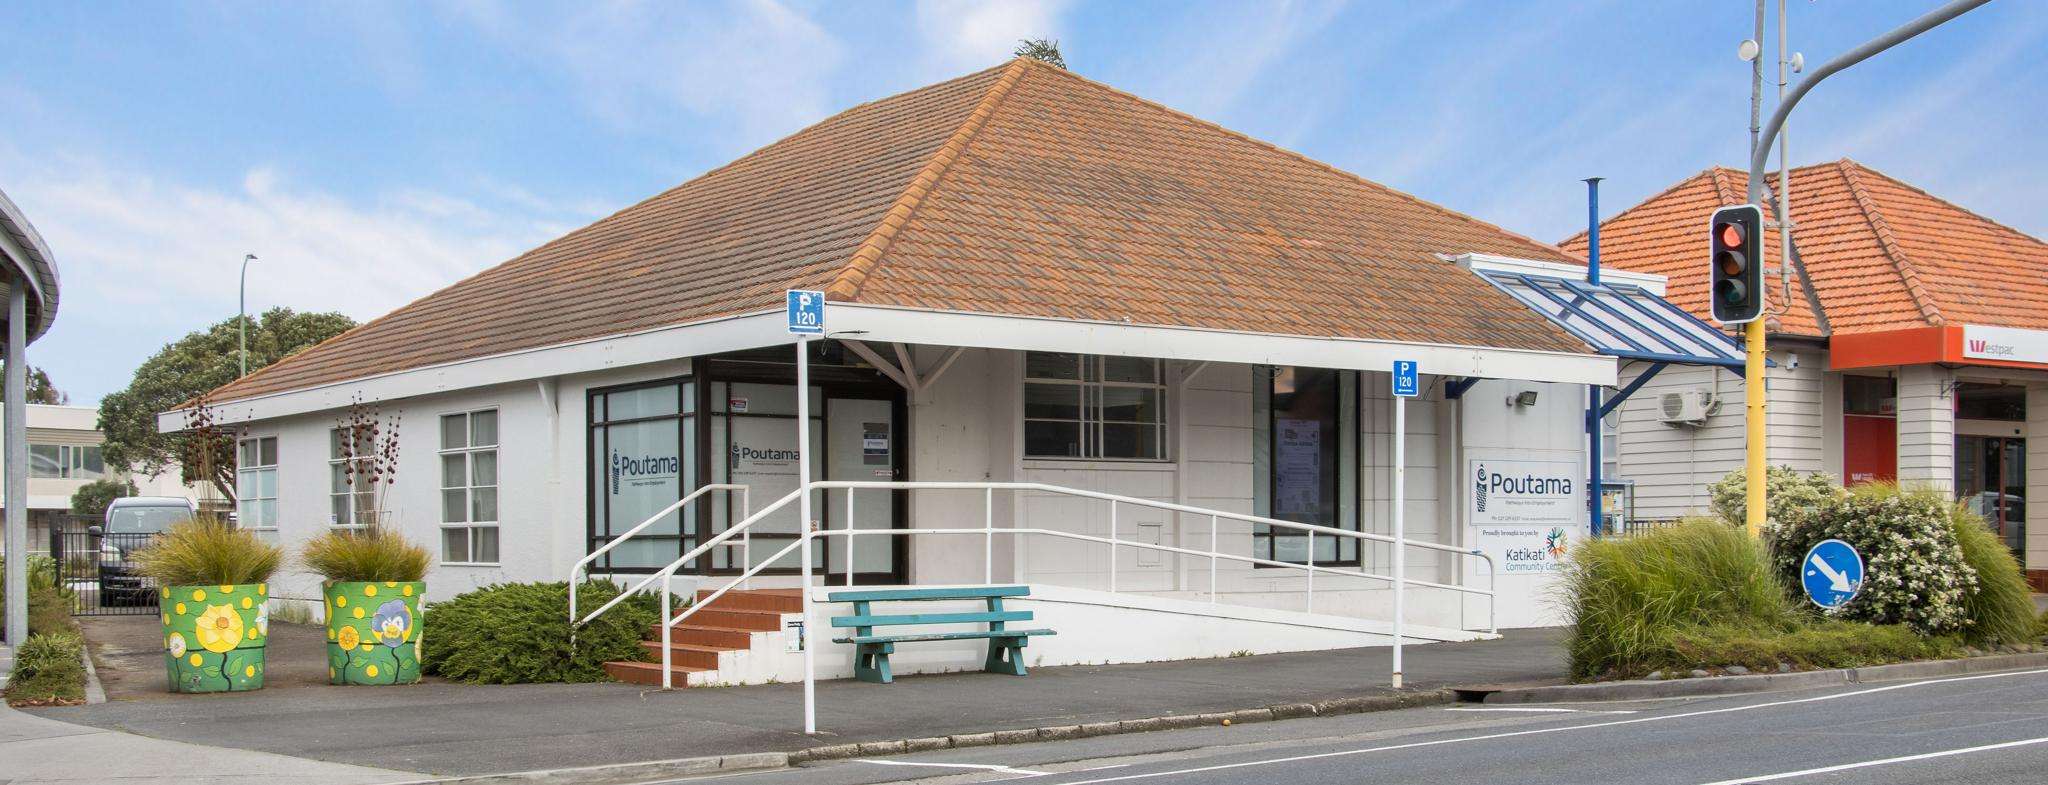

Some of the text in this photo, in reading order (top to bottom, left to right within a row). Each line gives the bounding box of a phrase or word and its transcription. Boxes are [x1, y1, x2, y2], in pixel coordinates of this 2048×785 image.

[799, 294, 812, 311] P
[796, 312, 816, 325] 120
[1969, 339, 2014, 356] Westpac
[1401, 362, 1409, 375] P
[1399, 376, 1412, 387] 120
[742, 446, 800, 461] Poutama
[622, 454, 678, 477] Poutama
[1491, 473, 1571, 494] Poutama
[1482, 529, 1500, 538] Proudly
[1501, 530, 1518, 538] brought
[1506, 548, 1545, 561] Katikati
[1506, 562, 1544, 572] Community
